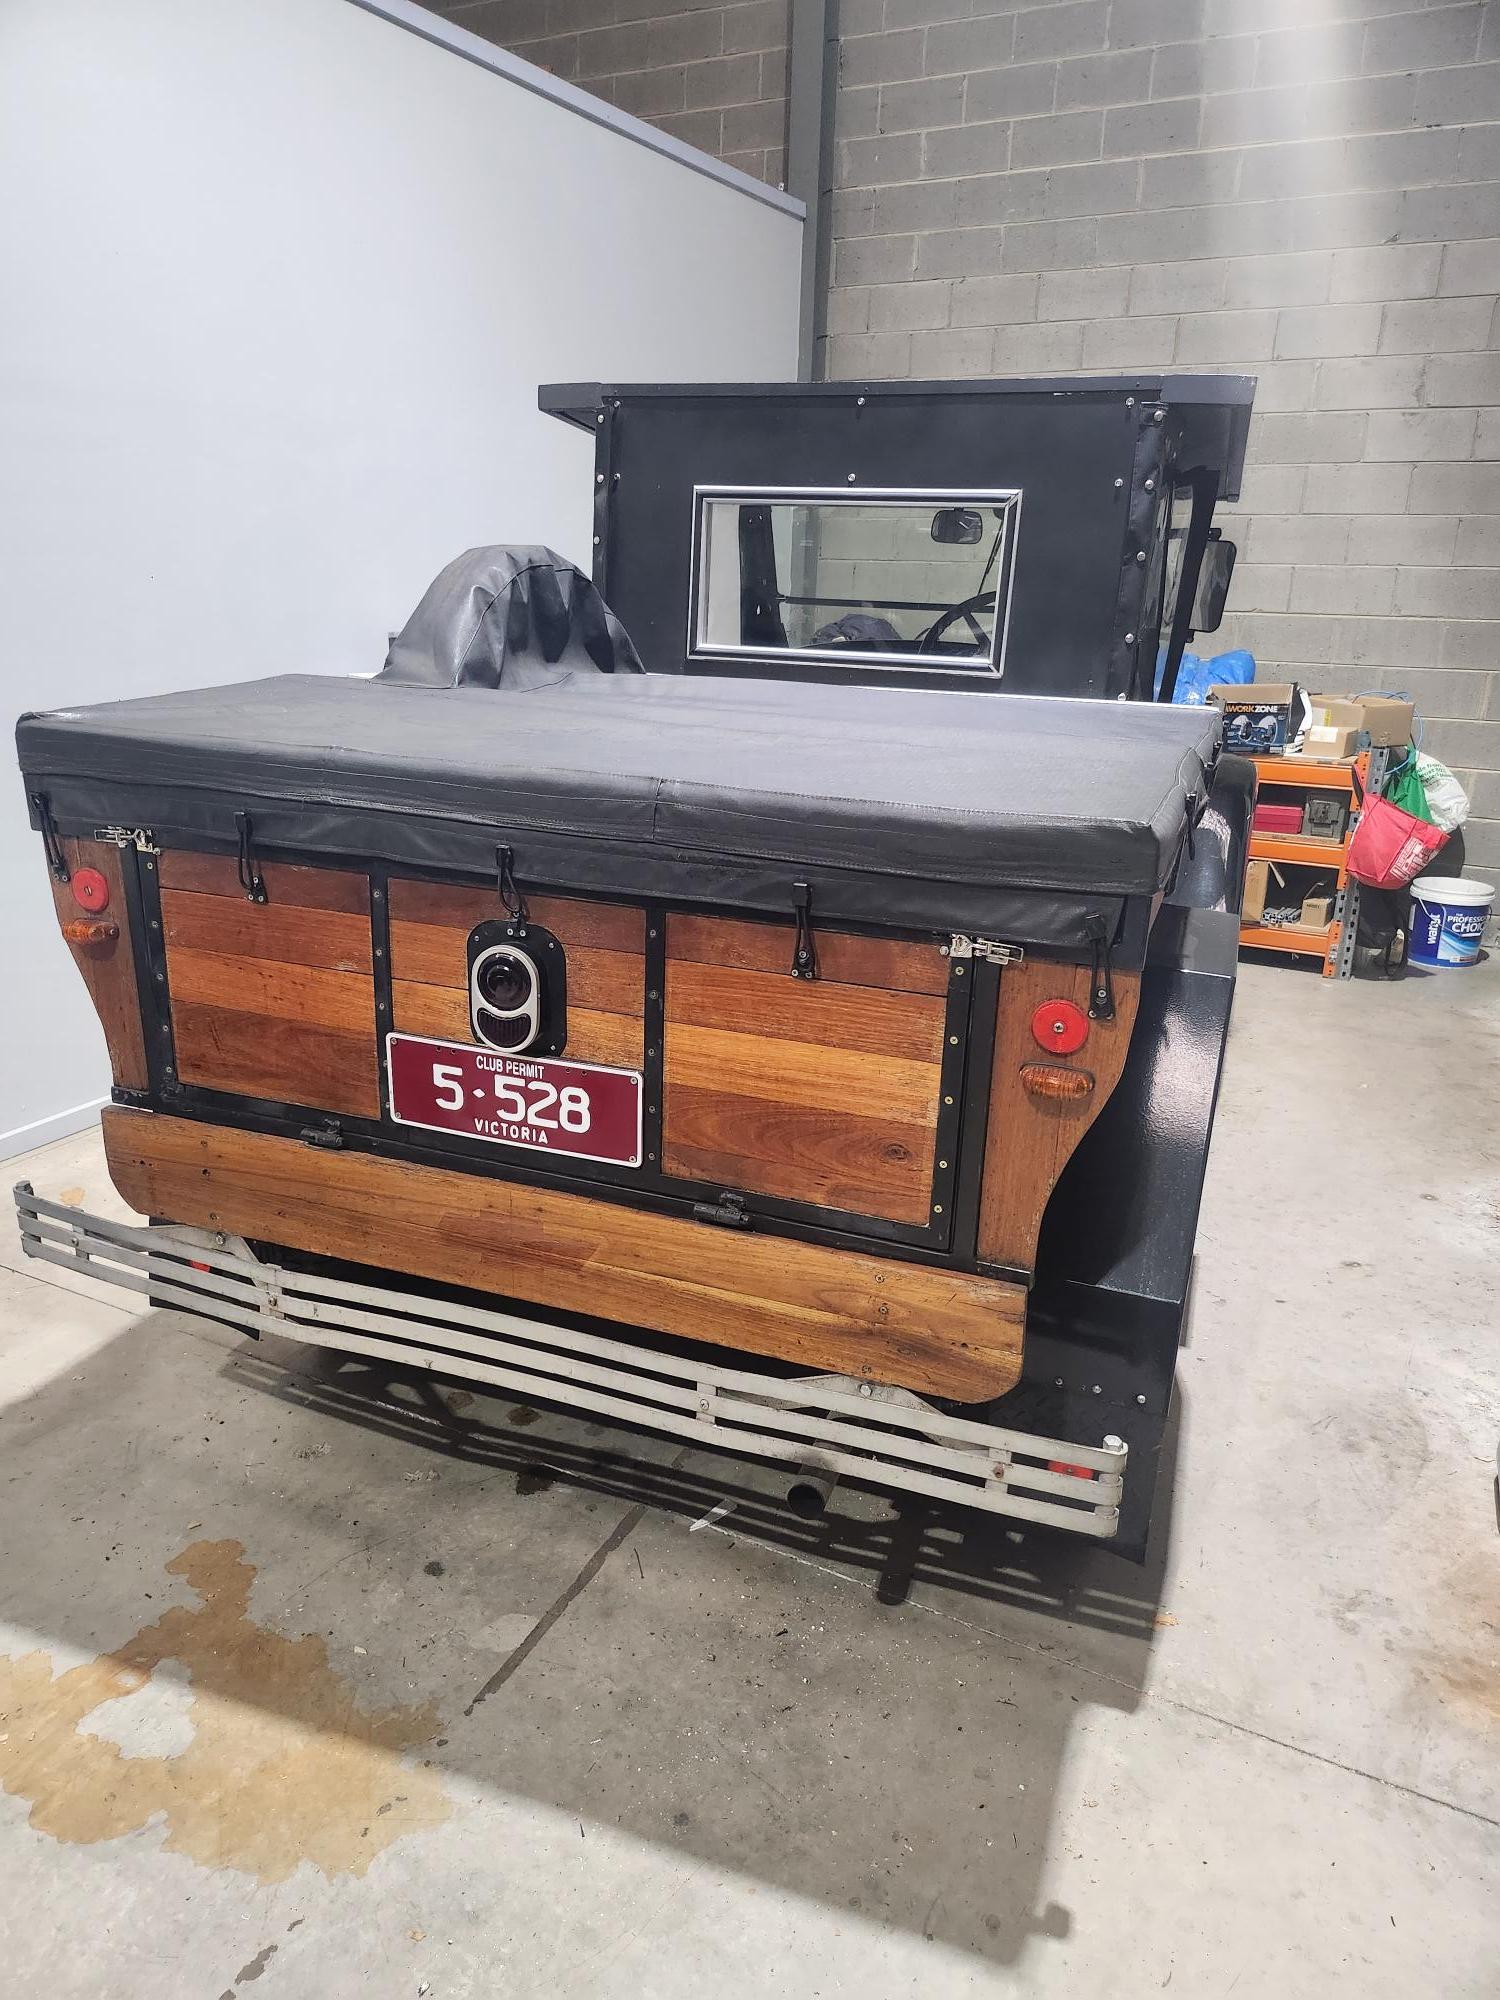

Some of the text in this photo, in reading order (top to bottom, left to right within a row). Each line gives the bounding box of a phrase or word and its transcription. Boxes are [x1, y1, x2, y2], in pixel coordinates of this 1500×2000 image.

[476, 1055, 544, 1078] CLUB PERMIT
[474, 1118, 548, 1144] VICTORIA
